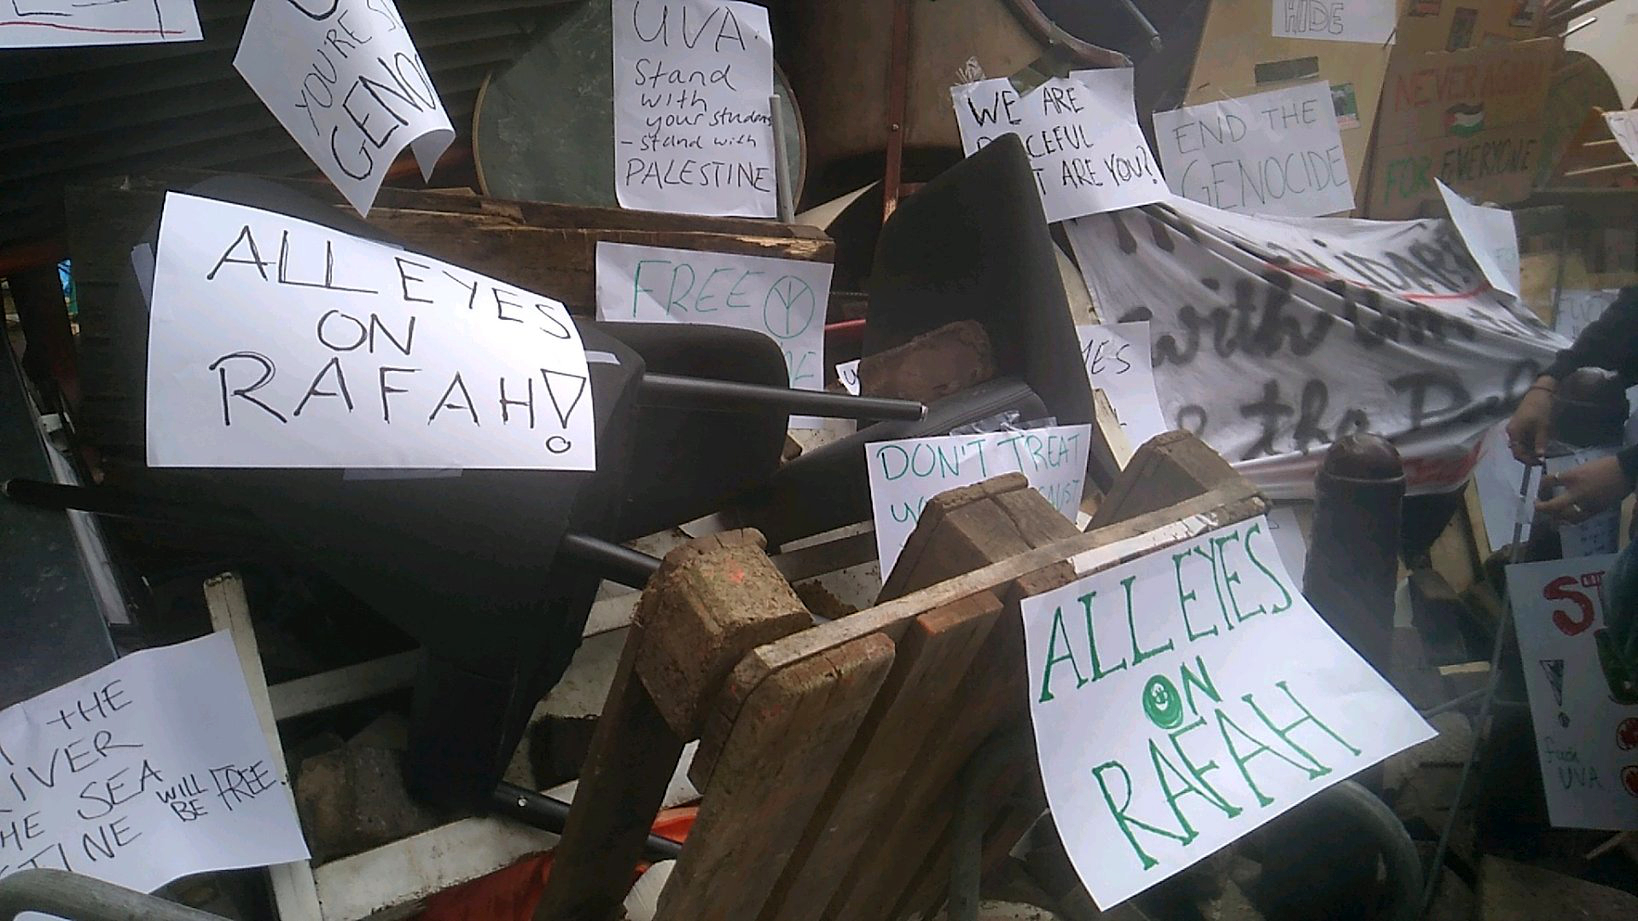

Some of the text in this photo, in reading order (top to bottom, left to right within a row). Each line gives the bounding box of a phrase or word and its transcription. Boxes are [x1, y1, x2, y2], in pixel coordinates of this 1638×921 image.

[1284, 0, 1345, 36] HIDE
[330, 52, 436, 181] GENO
[640, 89, 708, 113] with
[967, 87, 1085, 127] WE ARE
[1172, 99, 1319, 154] END THE
[625, 157, 772, 193] PALESTINE
[1060, 158, 1104, 190] ARE
[1103, 144, 1160, 188] YOU?
[1180, 144, 1349, 211] GENOCIDE
[206, 224, 571, 339] ALL EYES
[632, 259, 766, 319] FREE
[316, 309, 416, 357] ON
[876, 432, 1080, 481] DON'T TREAT
[1038, 522, 1293, 704] ALL EYES
[46, 679, 133, 730] THE
[1142, 655, 1223, 731] ON
[0, 730, 144, 813] IVER
[77, 760, 163, 820] SEA
[155, 773, 209, 804] WILL
[1091, 681, 1363, 872] RAFAH
[170, 799, 209, 821] BE
